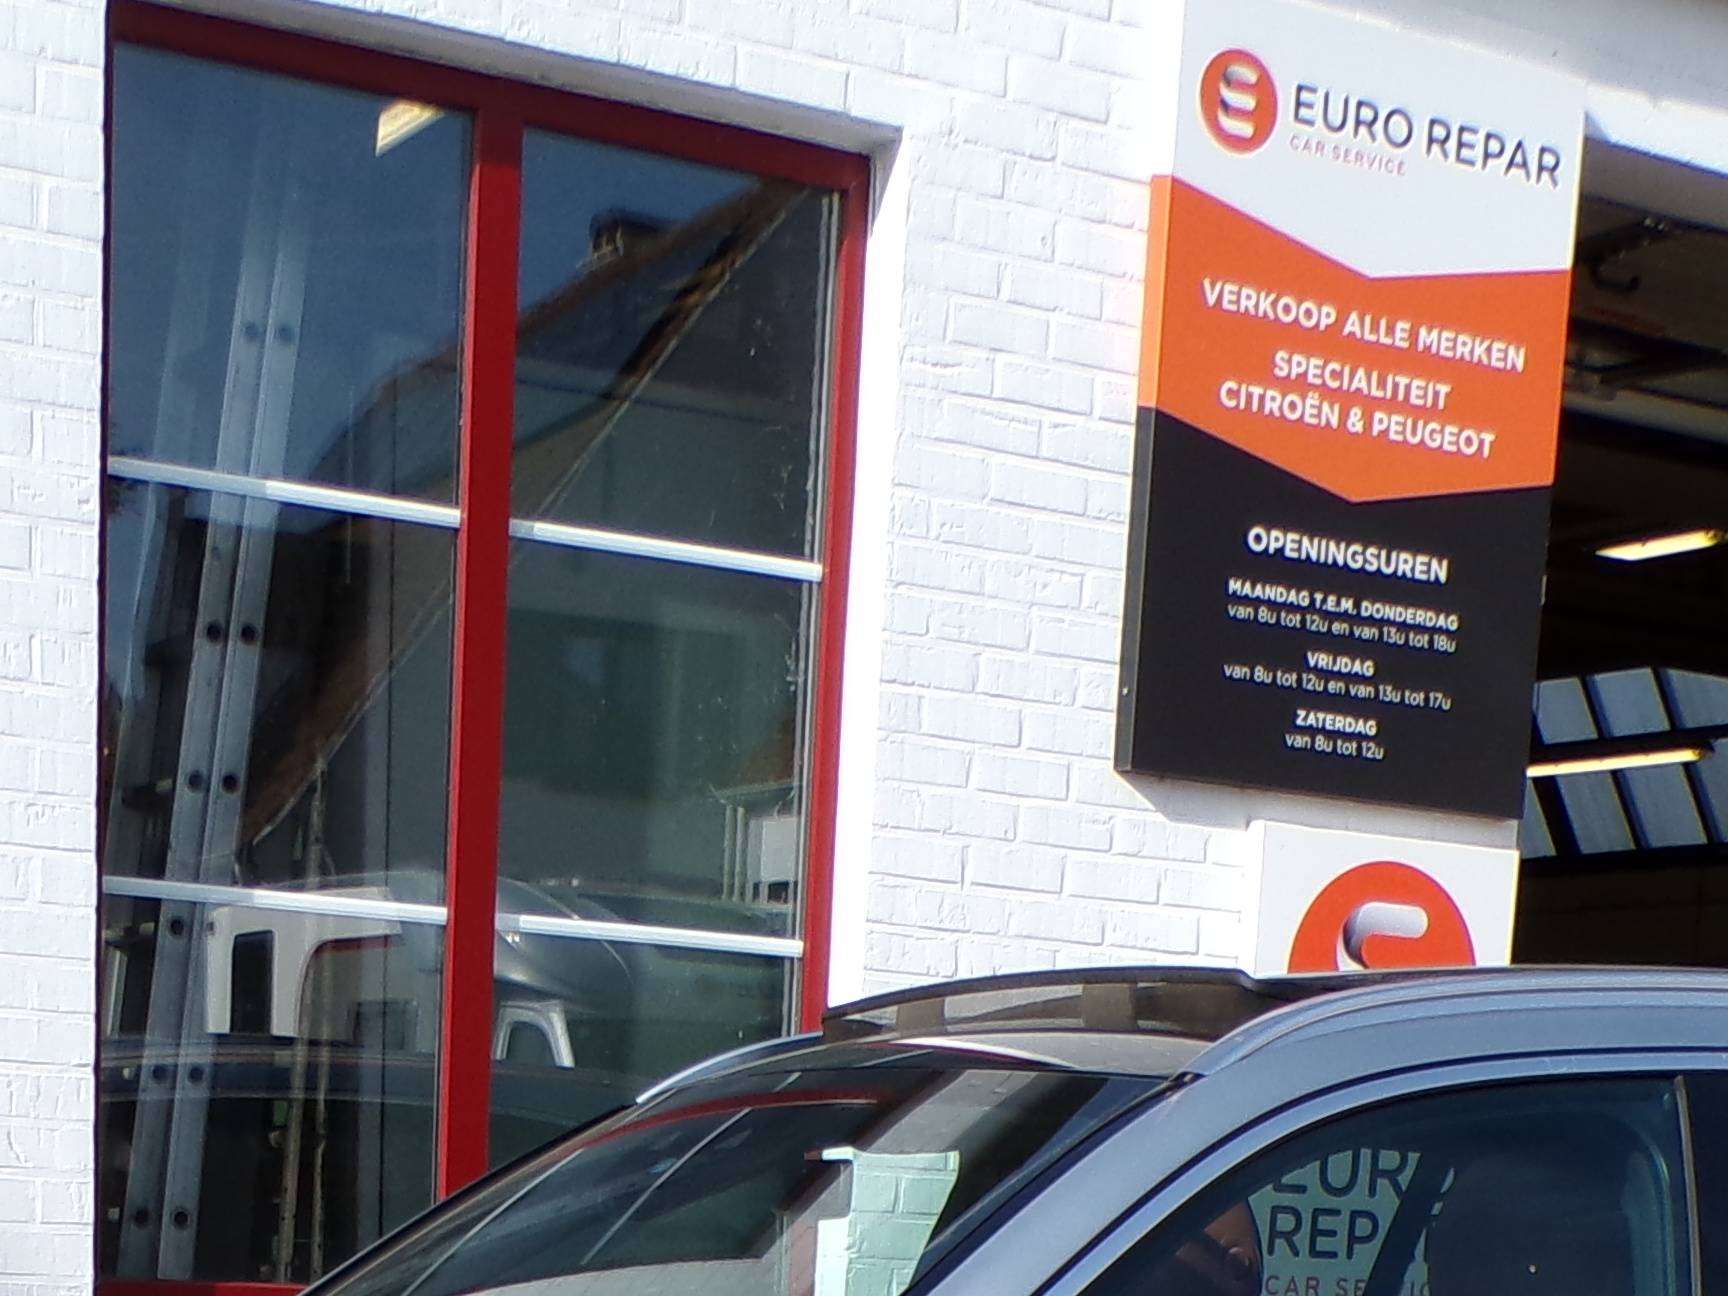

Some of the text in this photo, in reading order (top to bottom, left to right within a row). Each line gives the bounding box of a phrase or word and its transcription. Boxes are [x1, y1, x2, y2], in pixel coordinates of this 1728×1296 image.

[1289, 134, 1407, 177] CAR SERVICE
[1292, 82, 1562, 190] EURO REPAR
[1201, 277, 1526, 373] VERKOOP ALLE MERKEN
[1273, 350, 1453, 411] SPECIALITEIT
[1219, 379, 1496, 459] CITROËN & PEUGEOT
[1247, 526, 1450, 584] OPENINGSUREN
[1227, 577, 1459, 632] MAANDAG T.E.M. DONDERDAG
[1227, 603, 1457, 653] van 8u tot 12u en van 13u tot 18u
[1223, 664, 1452, 711] van 8u tot 12u en van 13u tot 17u
[1307, 651, 1376, 677] VRIJDAG
[1285, 733, 1385, 760] van 8u tot 12u
[1295, 709, 1378, 736] ZATERDAG
[1267, 1204, 1380, 1260] REP
